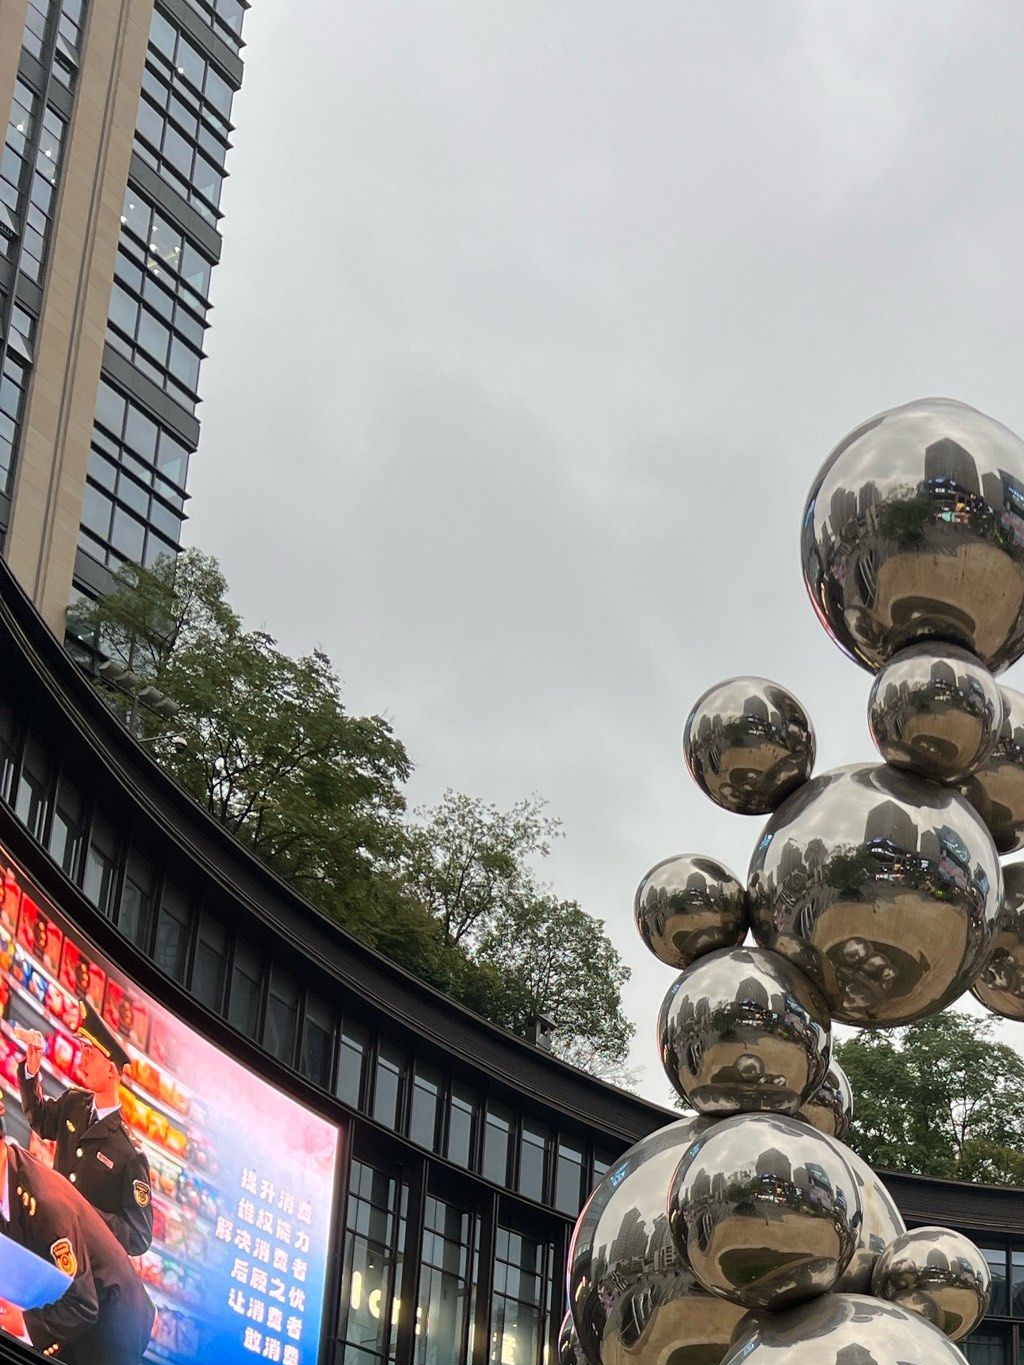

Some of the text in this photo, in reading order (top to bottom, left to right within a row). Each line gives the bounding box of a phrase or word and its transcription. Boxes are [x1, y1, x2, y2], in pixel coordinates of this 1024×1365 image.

[241, 1168, 312, 1225] 提升消费
[215, 1216, 307, 1282] 解决消费者
[238, 1198, 310, 1253] 维权能力
[231, 1258, 305, 1312] 后顾之忧
[228, 1288, 302, 1340] 让消费者
